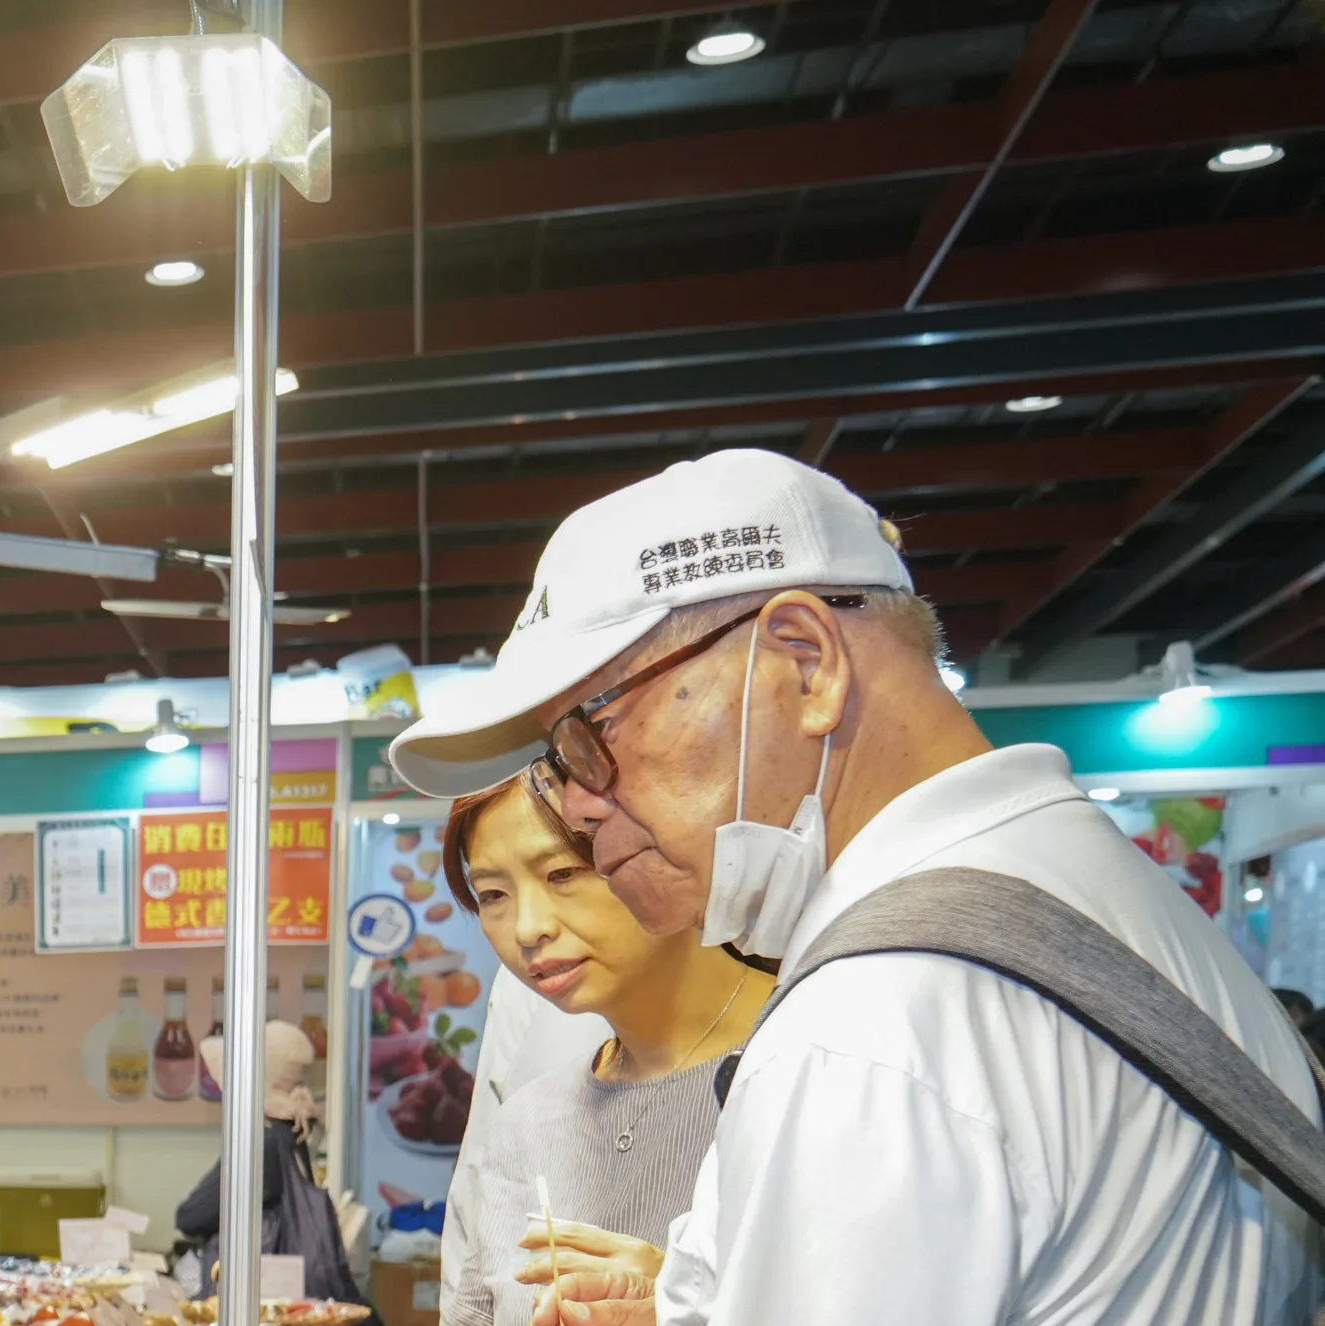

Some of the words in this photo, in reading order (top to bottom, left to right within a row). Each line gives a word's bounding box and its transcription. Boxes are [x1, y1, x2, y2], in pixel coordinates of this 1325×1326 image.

[640, 524, 782, 570] 台灣職業高爾夫
[642, 549, 785, 594] 專業教練委員會
